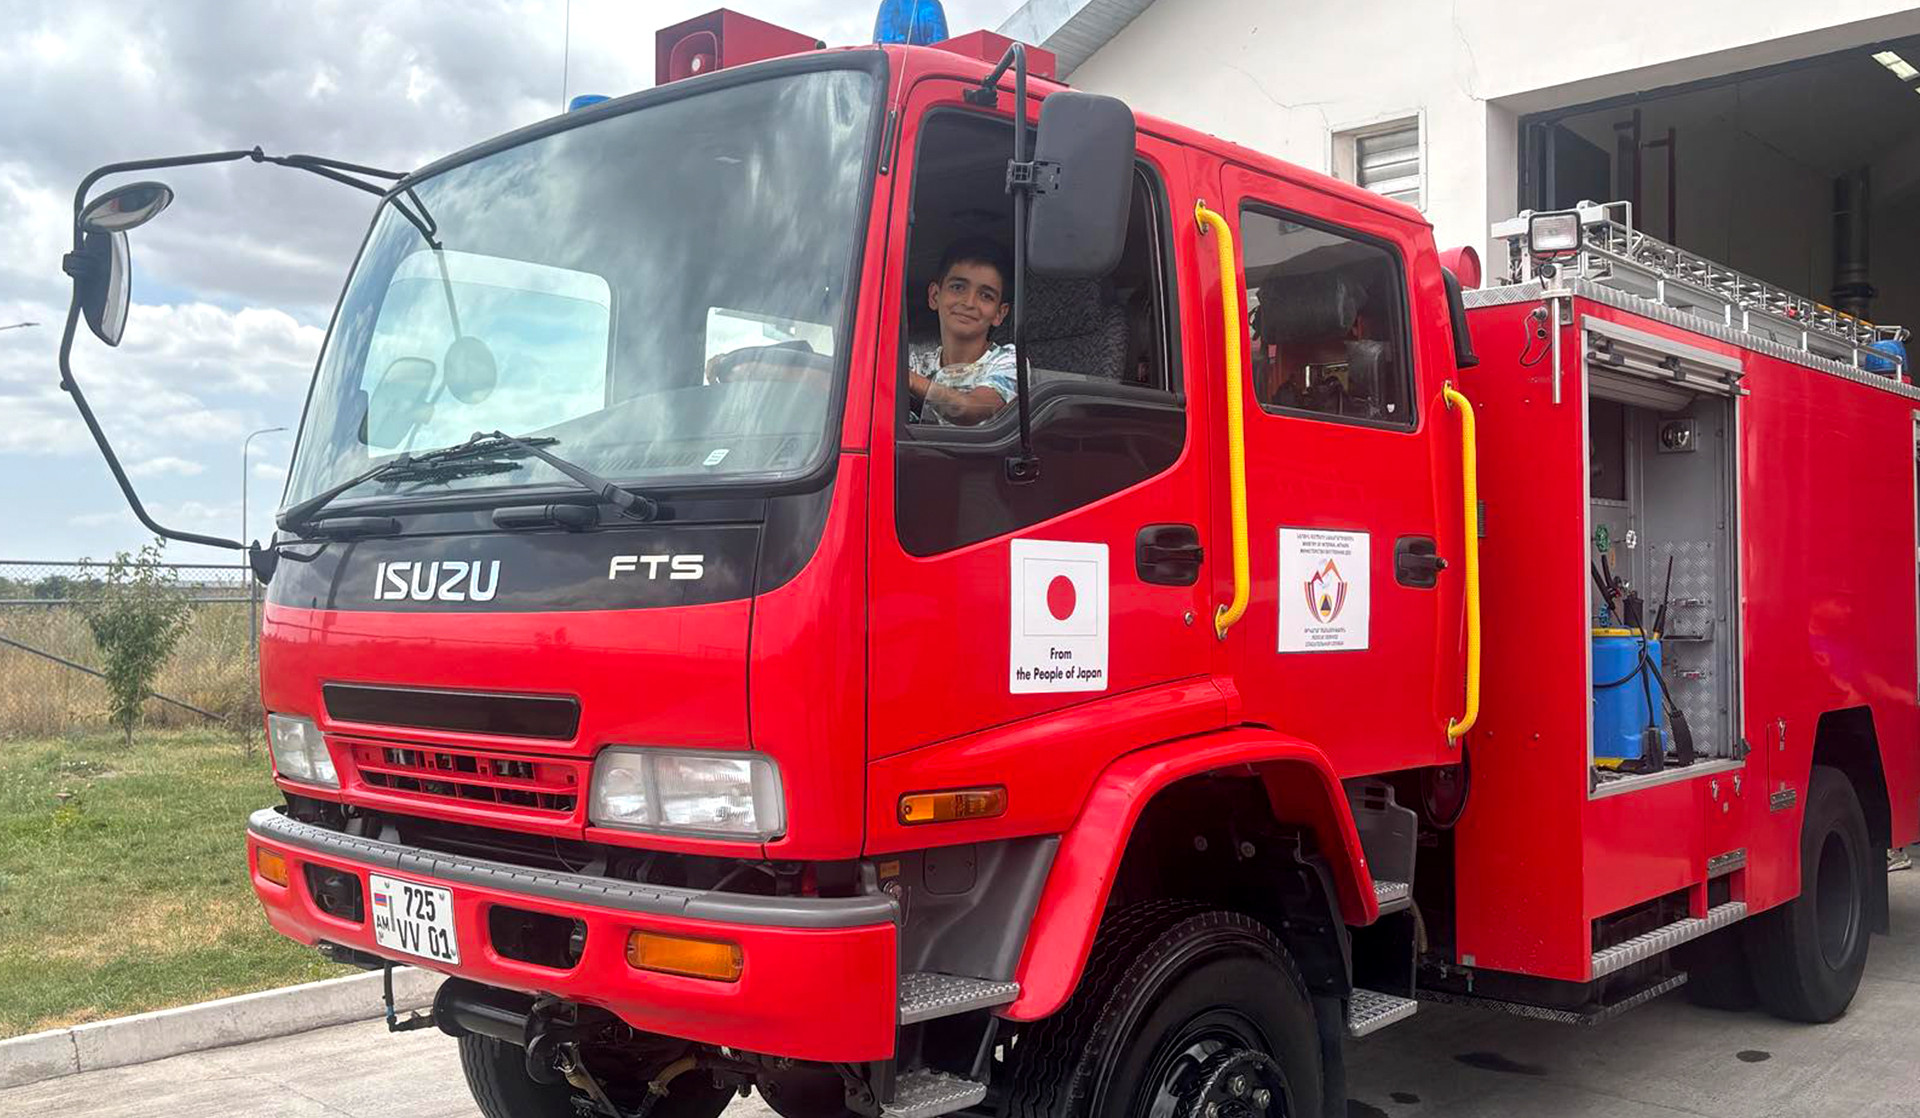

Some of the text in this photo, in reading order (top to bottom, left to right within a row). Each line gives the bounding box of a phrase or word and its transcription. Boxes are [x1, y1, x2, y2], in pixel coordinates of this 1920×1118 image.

[609, 554, 705, 580] FTS
[373, 560, 501, 602] ISUZU
[1050, 647, 1072, 660] From
[1016, 665, 1102, 683] the People of Japan
[403, 886, 436, 922] 725
[376, 914, 390, 931] AM
[396, 918, 452, 959] VV 01
